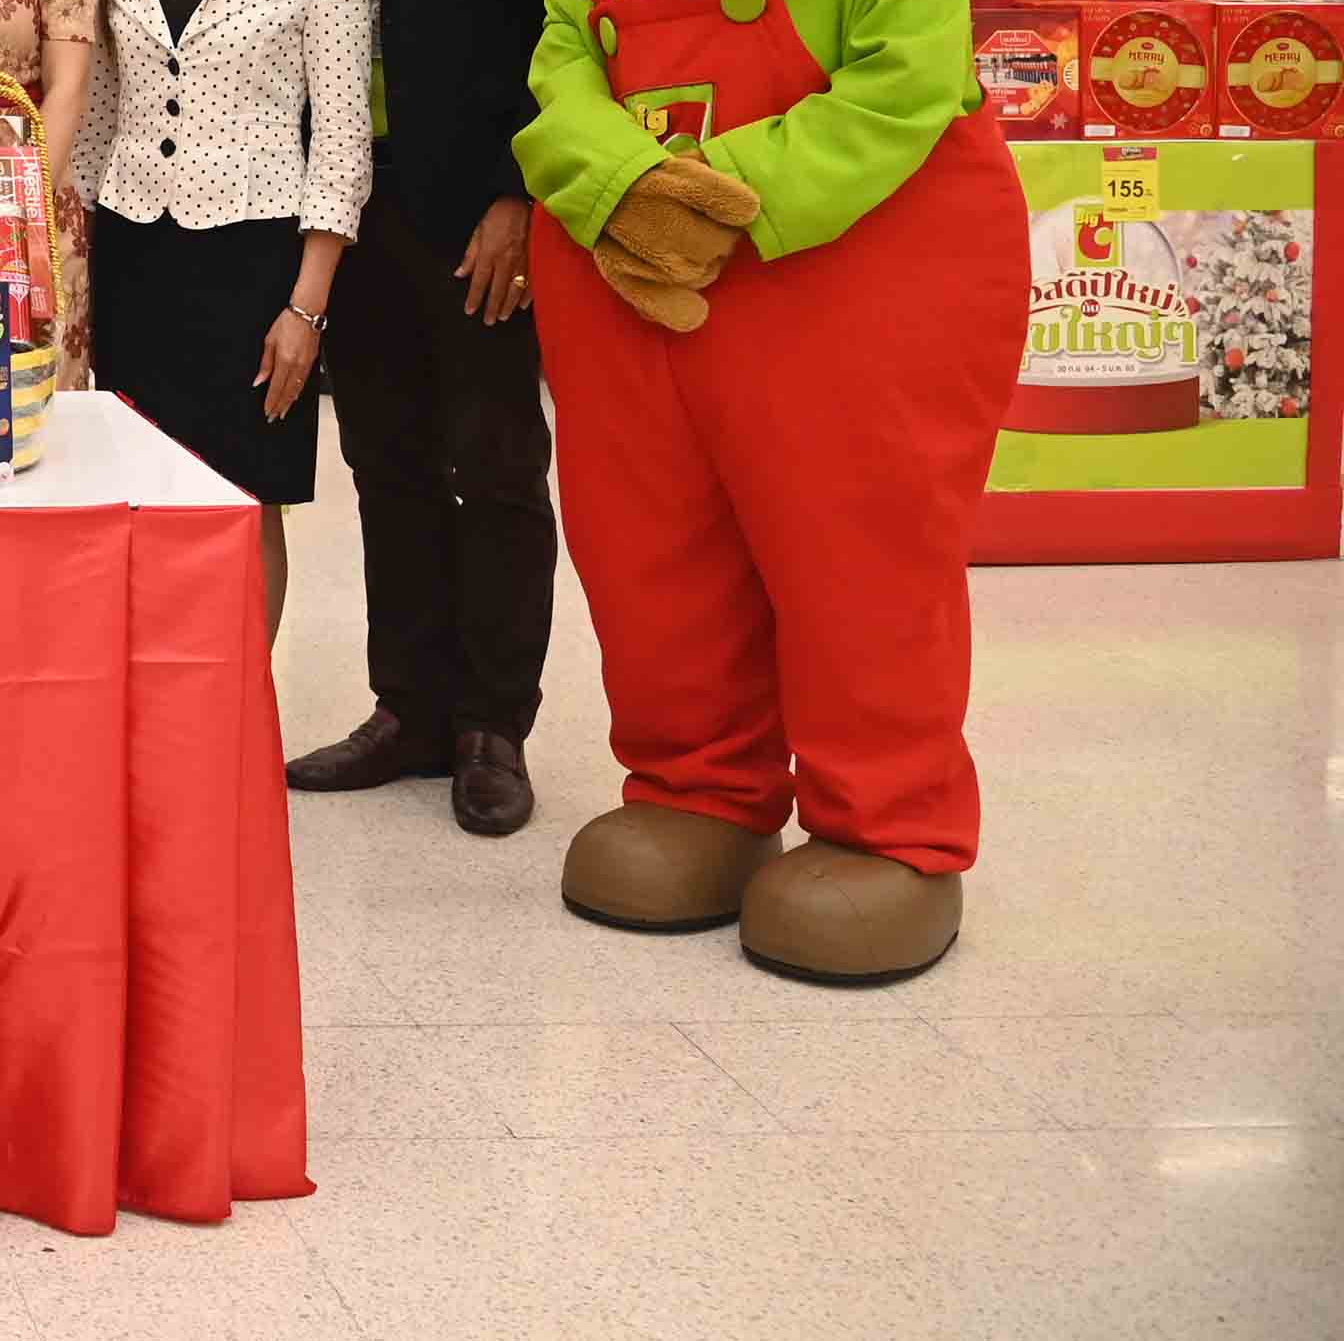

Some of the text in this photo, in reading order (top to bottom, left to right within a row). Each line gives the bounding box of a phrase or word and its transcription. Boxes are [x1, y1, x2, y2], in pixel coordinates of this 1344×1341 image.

[1128, 49, 1165, 65] MERRY
[1264, 51, 1302, 65] MERRY
[1108, 180, 1144, 198] 155
